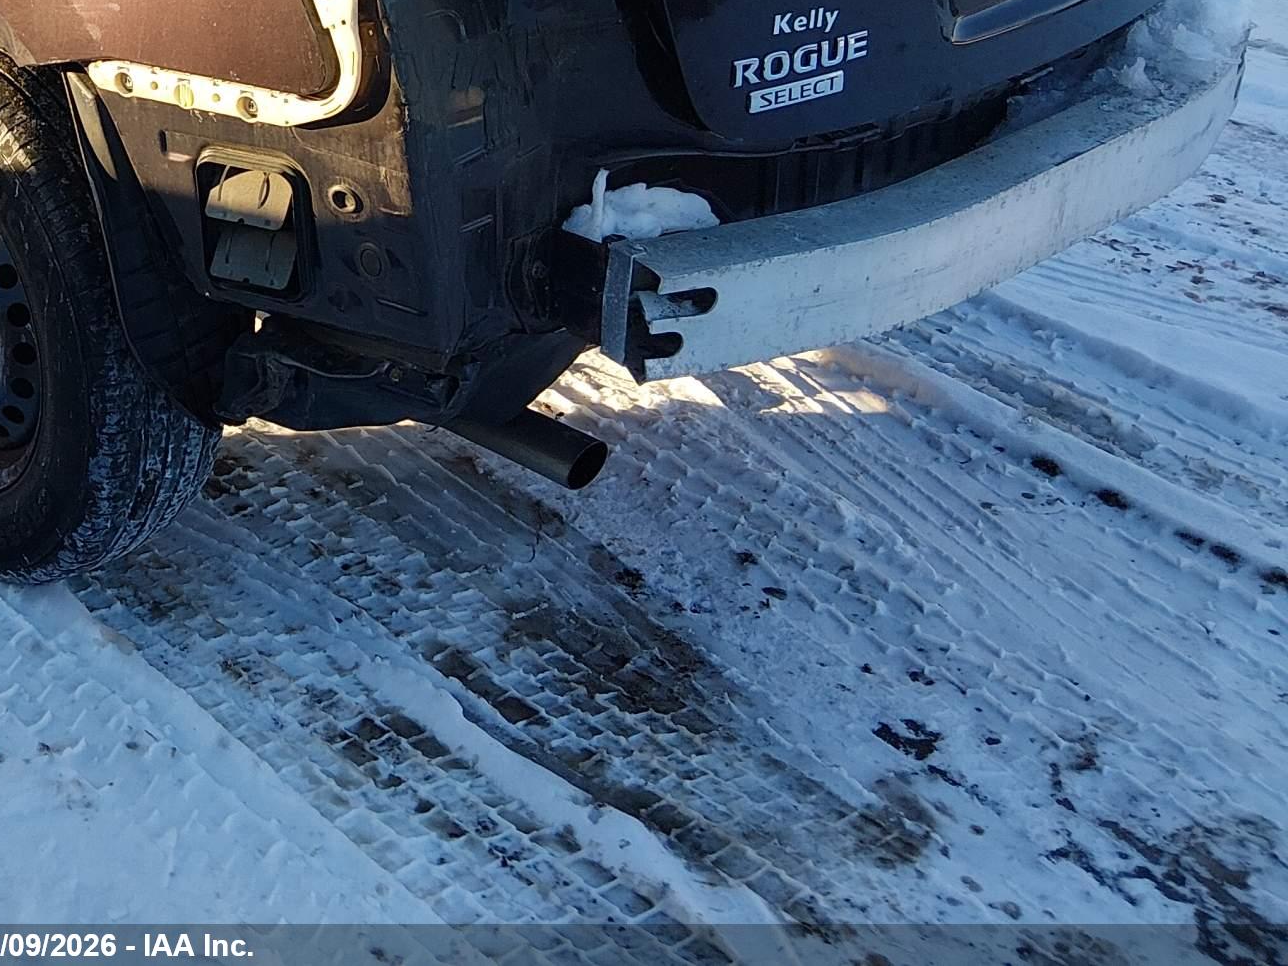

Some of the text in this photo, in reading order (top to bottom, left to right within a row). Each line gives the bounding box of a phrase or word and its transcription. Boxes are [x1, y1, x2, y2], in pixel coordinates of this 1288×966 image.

[773, 7, 839, 35] Kelly
[734, 30, 868, 88] ROGUE
[759, 76, 840, 109] SELECT
